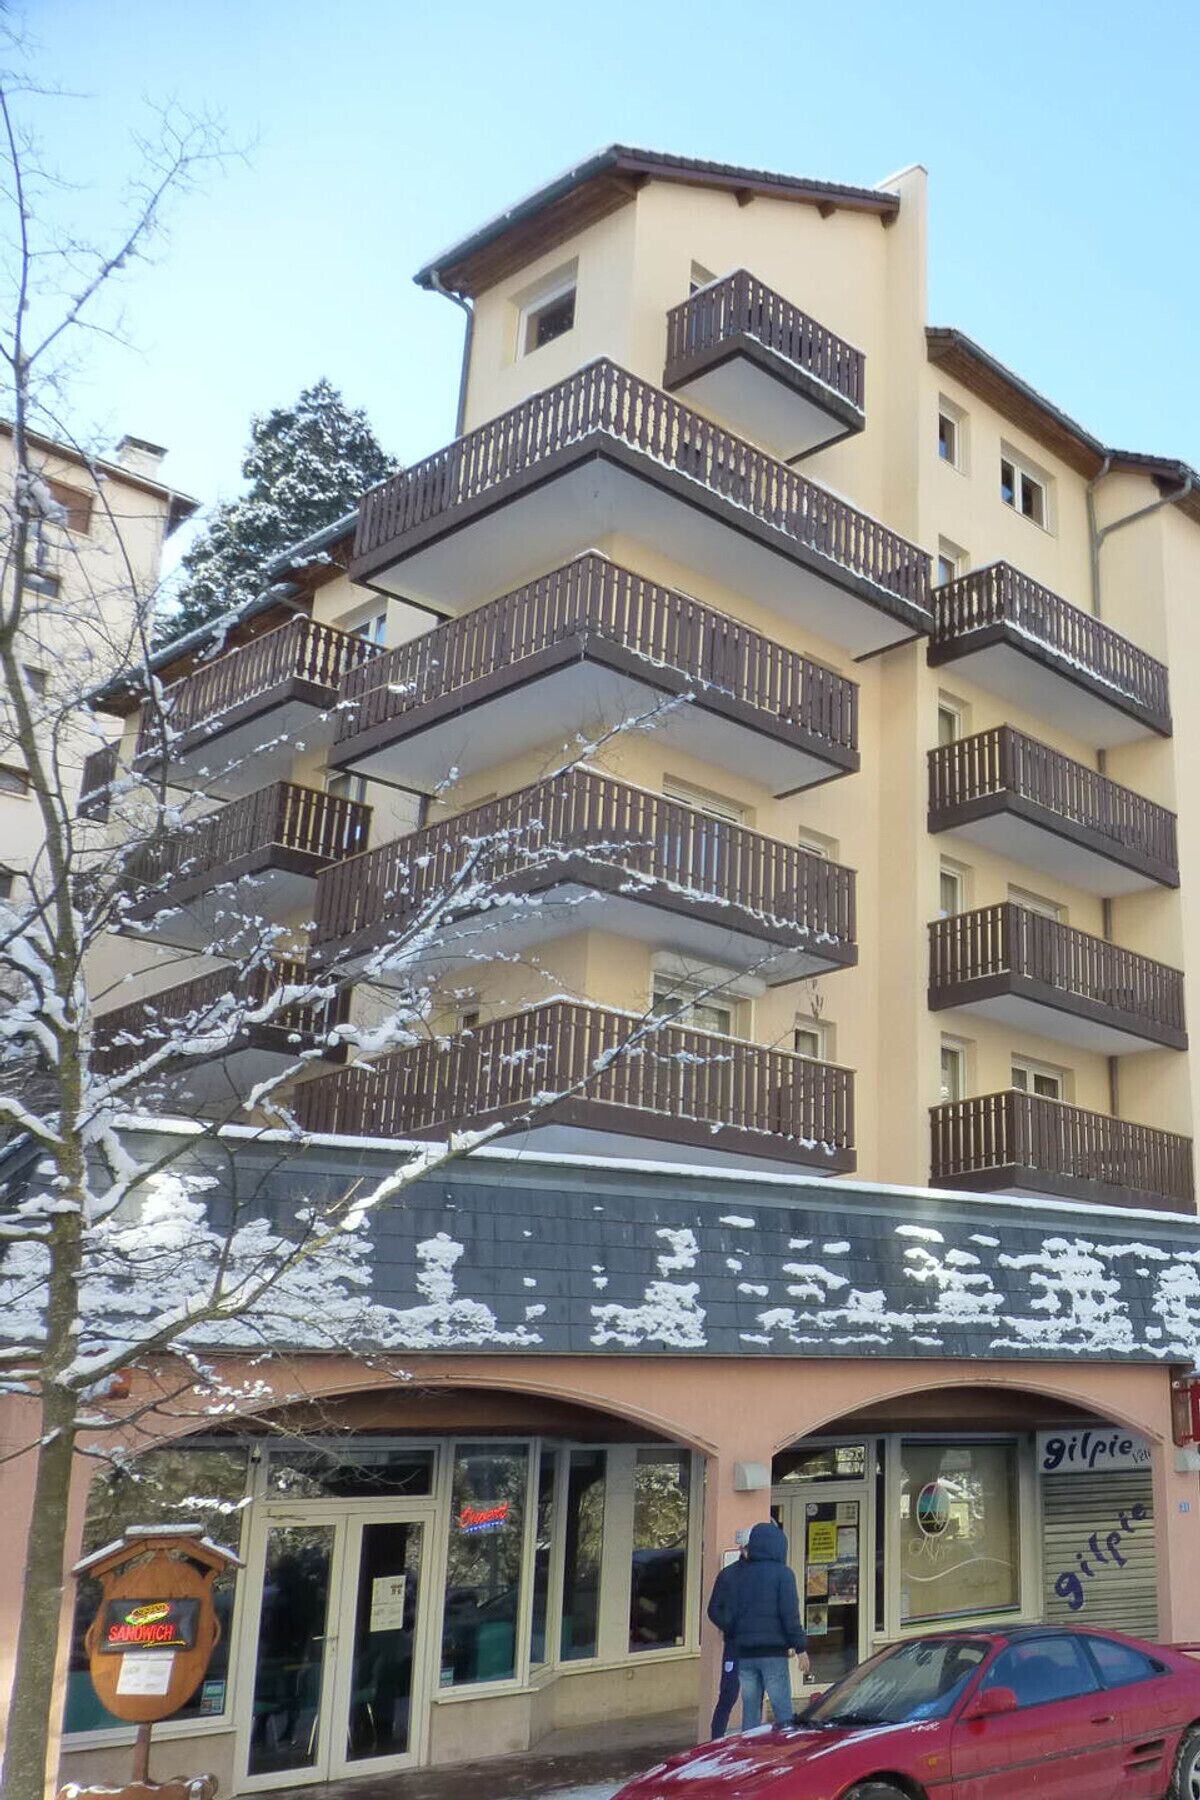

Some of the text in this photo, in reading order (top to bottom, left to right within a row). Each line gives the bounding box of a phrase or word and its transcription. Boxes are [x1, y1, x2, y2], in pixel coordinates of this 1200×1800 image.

[1043, 1432, 1133, 1470] gilpie
[1055, 1503, 1146, 1610] gilpie
[108, 1623, 176, 1640] SANDWICH
